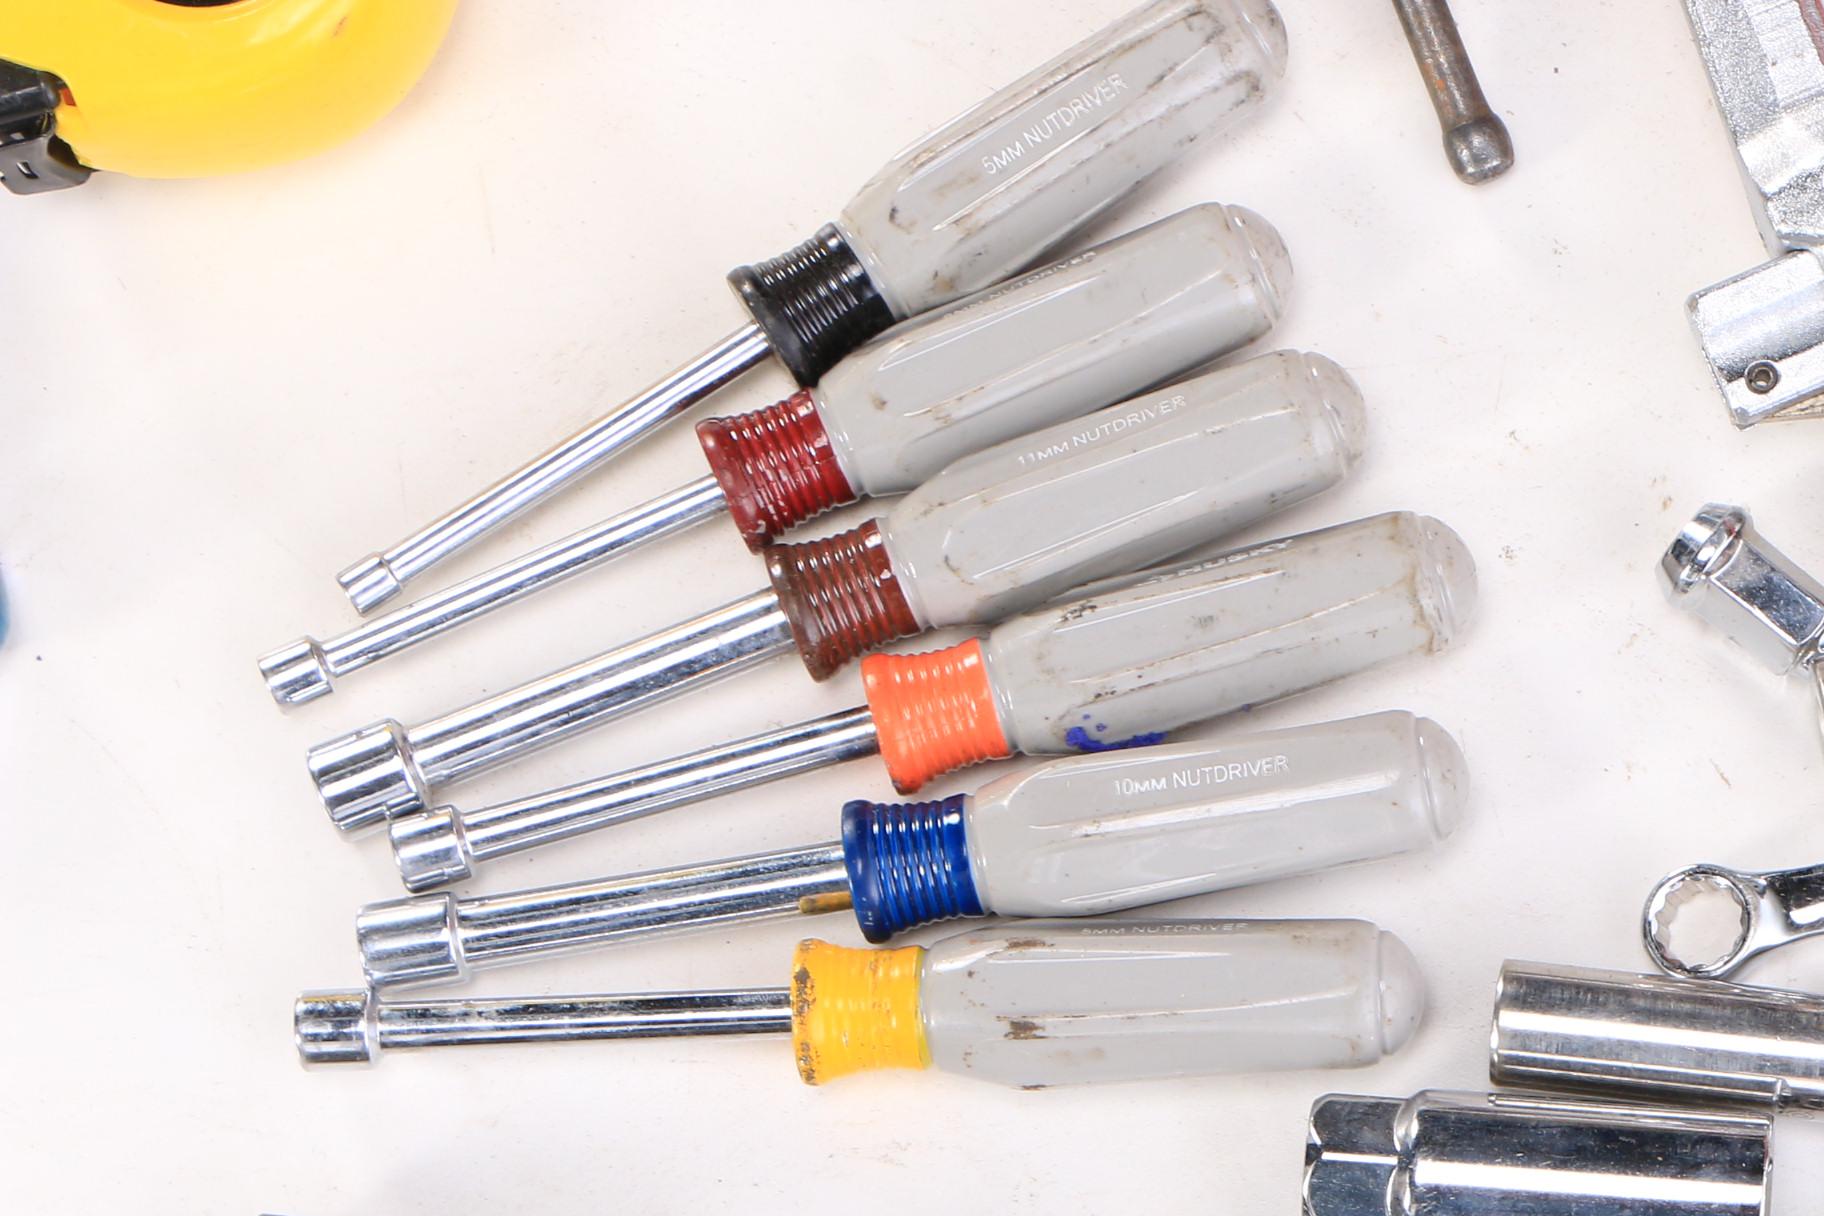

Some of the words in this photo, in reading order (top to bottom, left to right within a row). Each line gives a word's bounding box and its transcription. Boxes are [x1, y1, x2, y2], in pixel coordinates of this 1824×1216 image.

[982, 140, 1025, 175] 5MM
[1023, 73, 1128, 148] NUTDRIVER
[1016, 441, 1070, 466] 11MM
[1071, 394, 1187, 448] NUTDRIVER
[1114, 776, 1168, 796] 10MM
[1171, 754, 1291, 789] NUTDRIVER
[1131, 922, 1249, 936] NUTDRIVER
